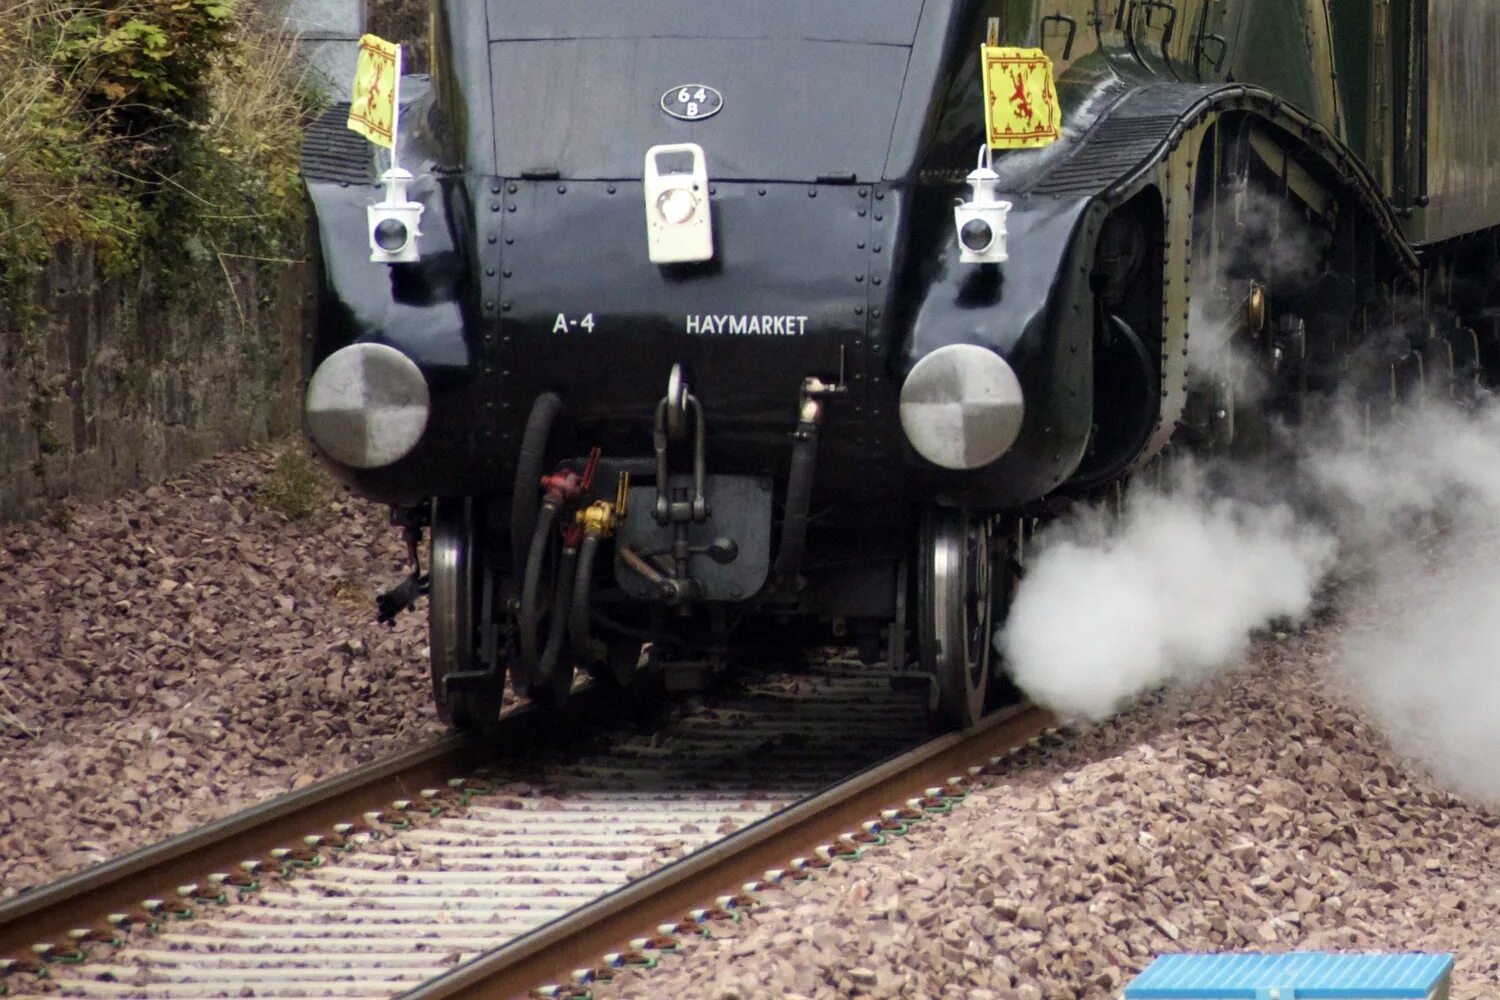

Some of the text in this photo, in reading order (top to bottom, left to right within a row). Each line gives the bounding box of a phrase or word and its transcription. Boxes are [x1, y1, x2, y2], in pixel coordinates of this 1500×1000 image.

[686, 103, 699, 117] B
[552, 312, 595, 334] A-4
[686, 314, 808, 335] HAYMARKET
